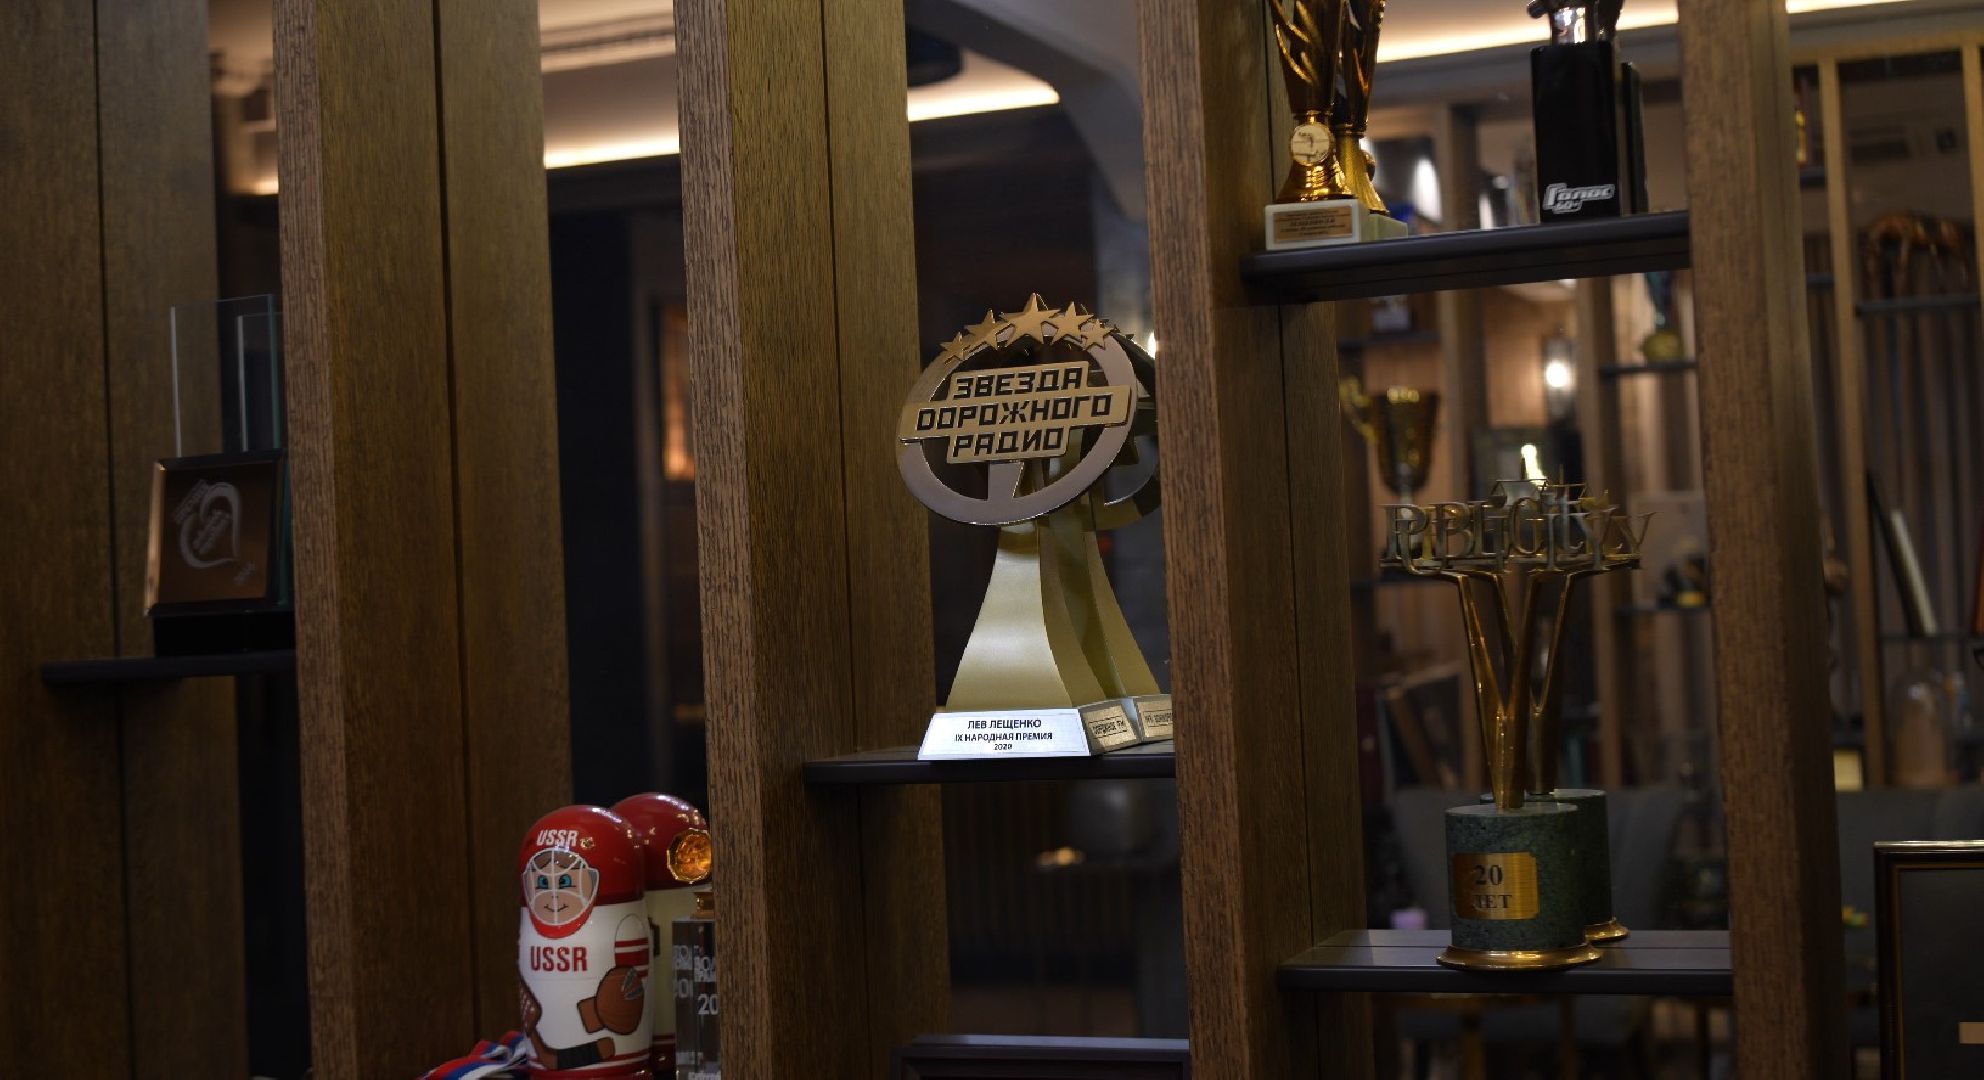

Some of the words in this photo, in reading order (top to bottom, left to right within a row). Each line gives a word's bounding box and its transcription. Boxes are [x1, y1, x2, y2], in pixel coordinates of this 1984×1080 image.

[953, 367, 1083, 400] ЗВЕЗДА
[952, 426, 1064, 458] РАДИО
[967, 720, 987, 730] ЛЕВ
[989, 718, 1042, 730] ЛЕЩЕНКО
[965, 733, 1014, 743] НАРОДНАЯ
[1015, 732, 1053, 741] ПРЕМИЯ
[536, 829, 578, 848] USSR
[1472, 864, 1503, 886] 20
[530, 945, 588, 972] USSR
